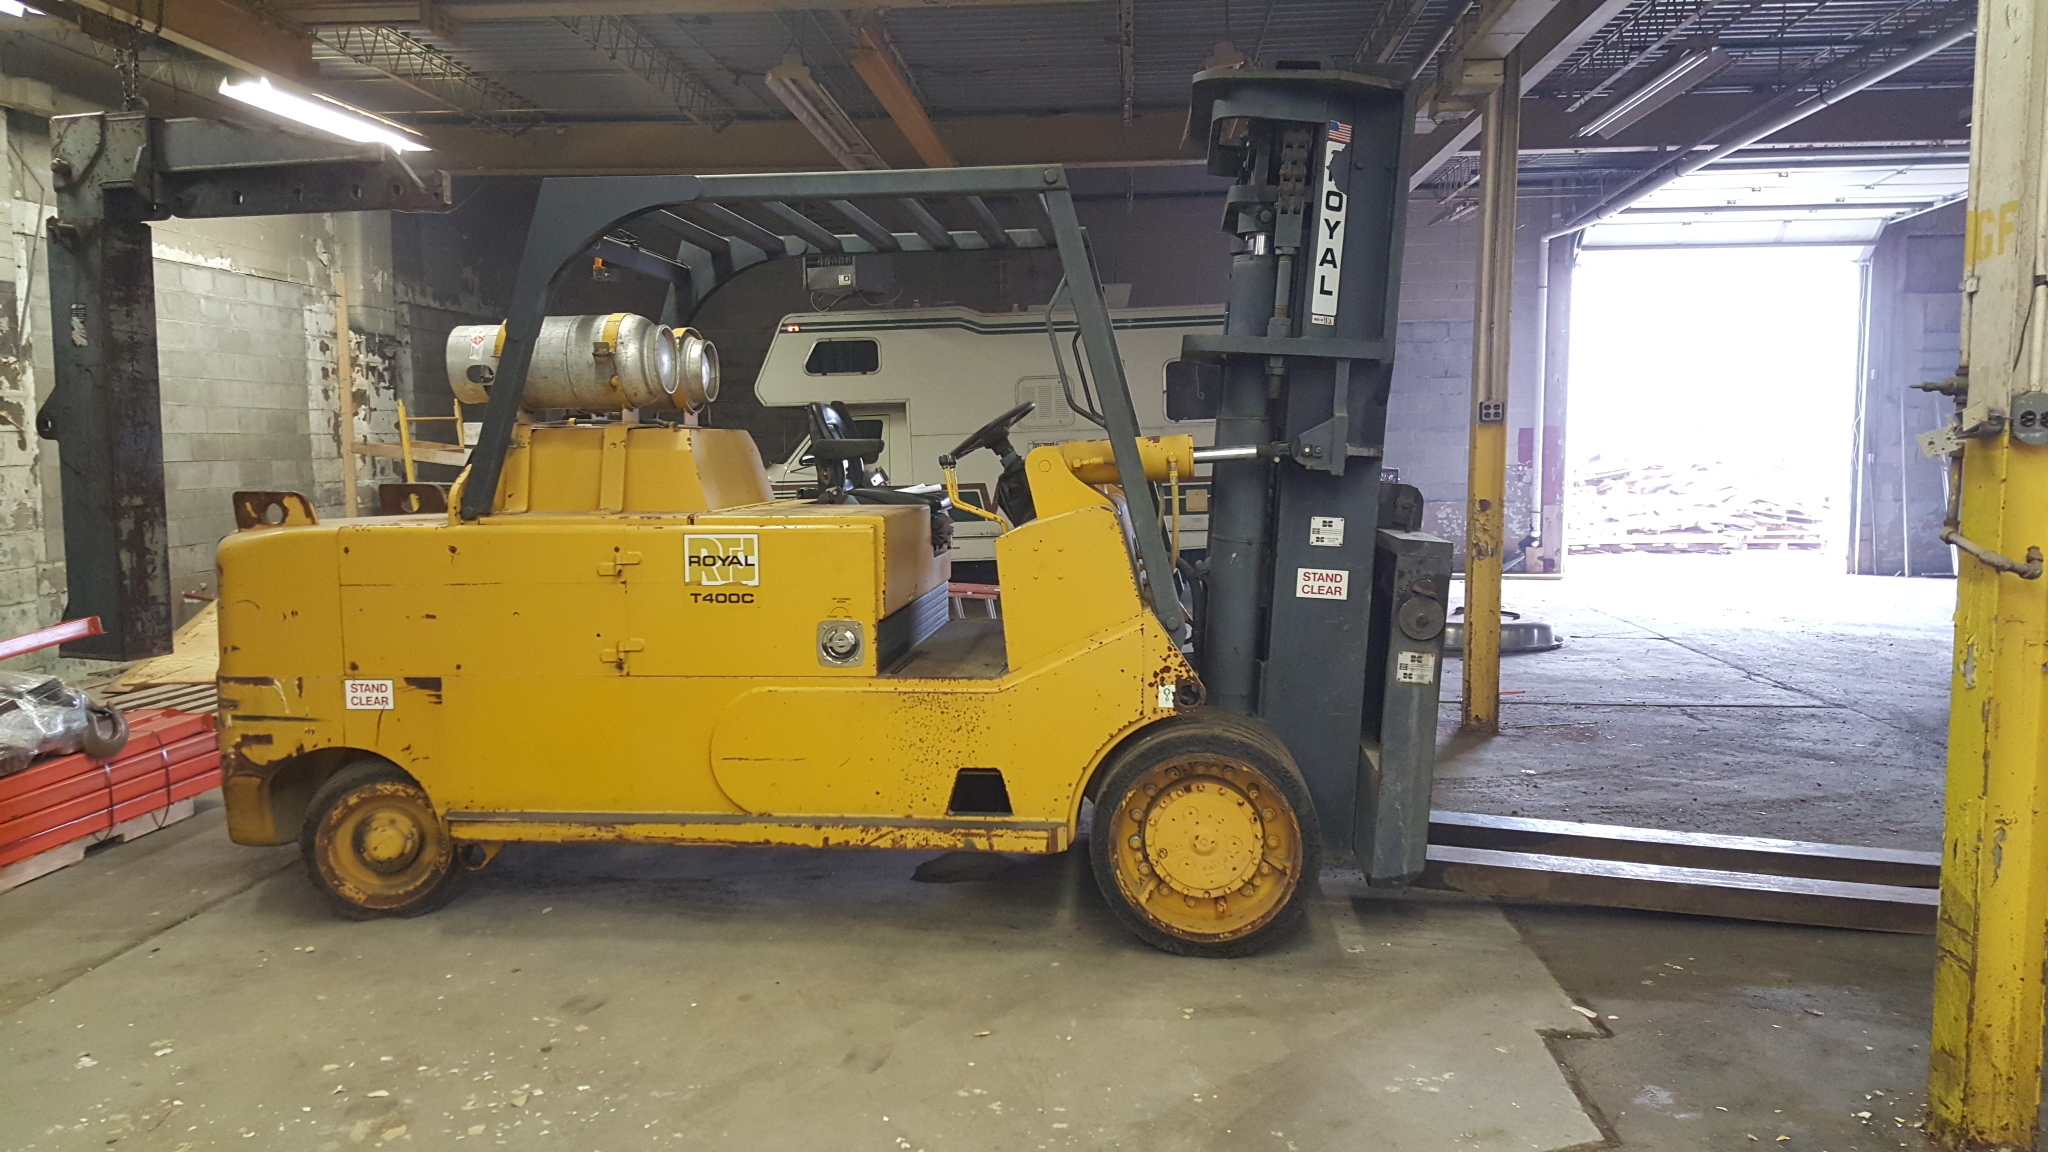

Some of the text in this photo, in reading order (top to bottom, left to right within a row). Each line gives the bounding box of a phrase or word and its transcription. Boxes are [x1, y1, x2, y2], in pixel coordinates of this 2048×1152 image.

[1319, 171, 1343, 296] OYAL
[688, 555, 755, 567] ROYAL
[1302, 572, 1343, 583] STAND
[1301, 584, 1342, 596] CLEAR
[690, 593, 754, 604] T400C
[350, 683, 388, 693] STAND
[350, 696, 389, 706] CLEAR
